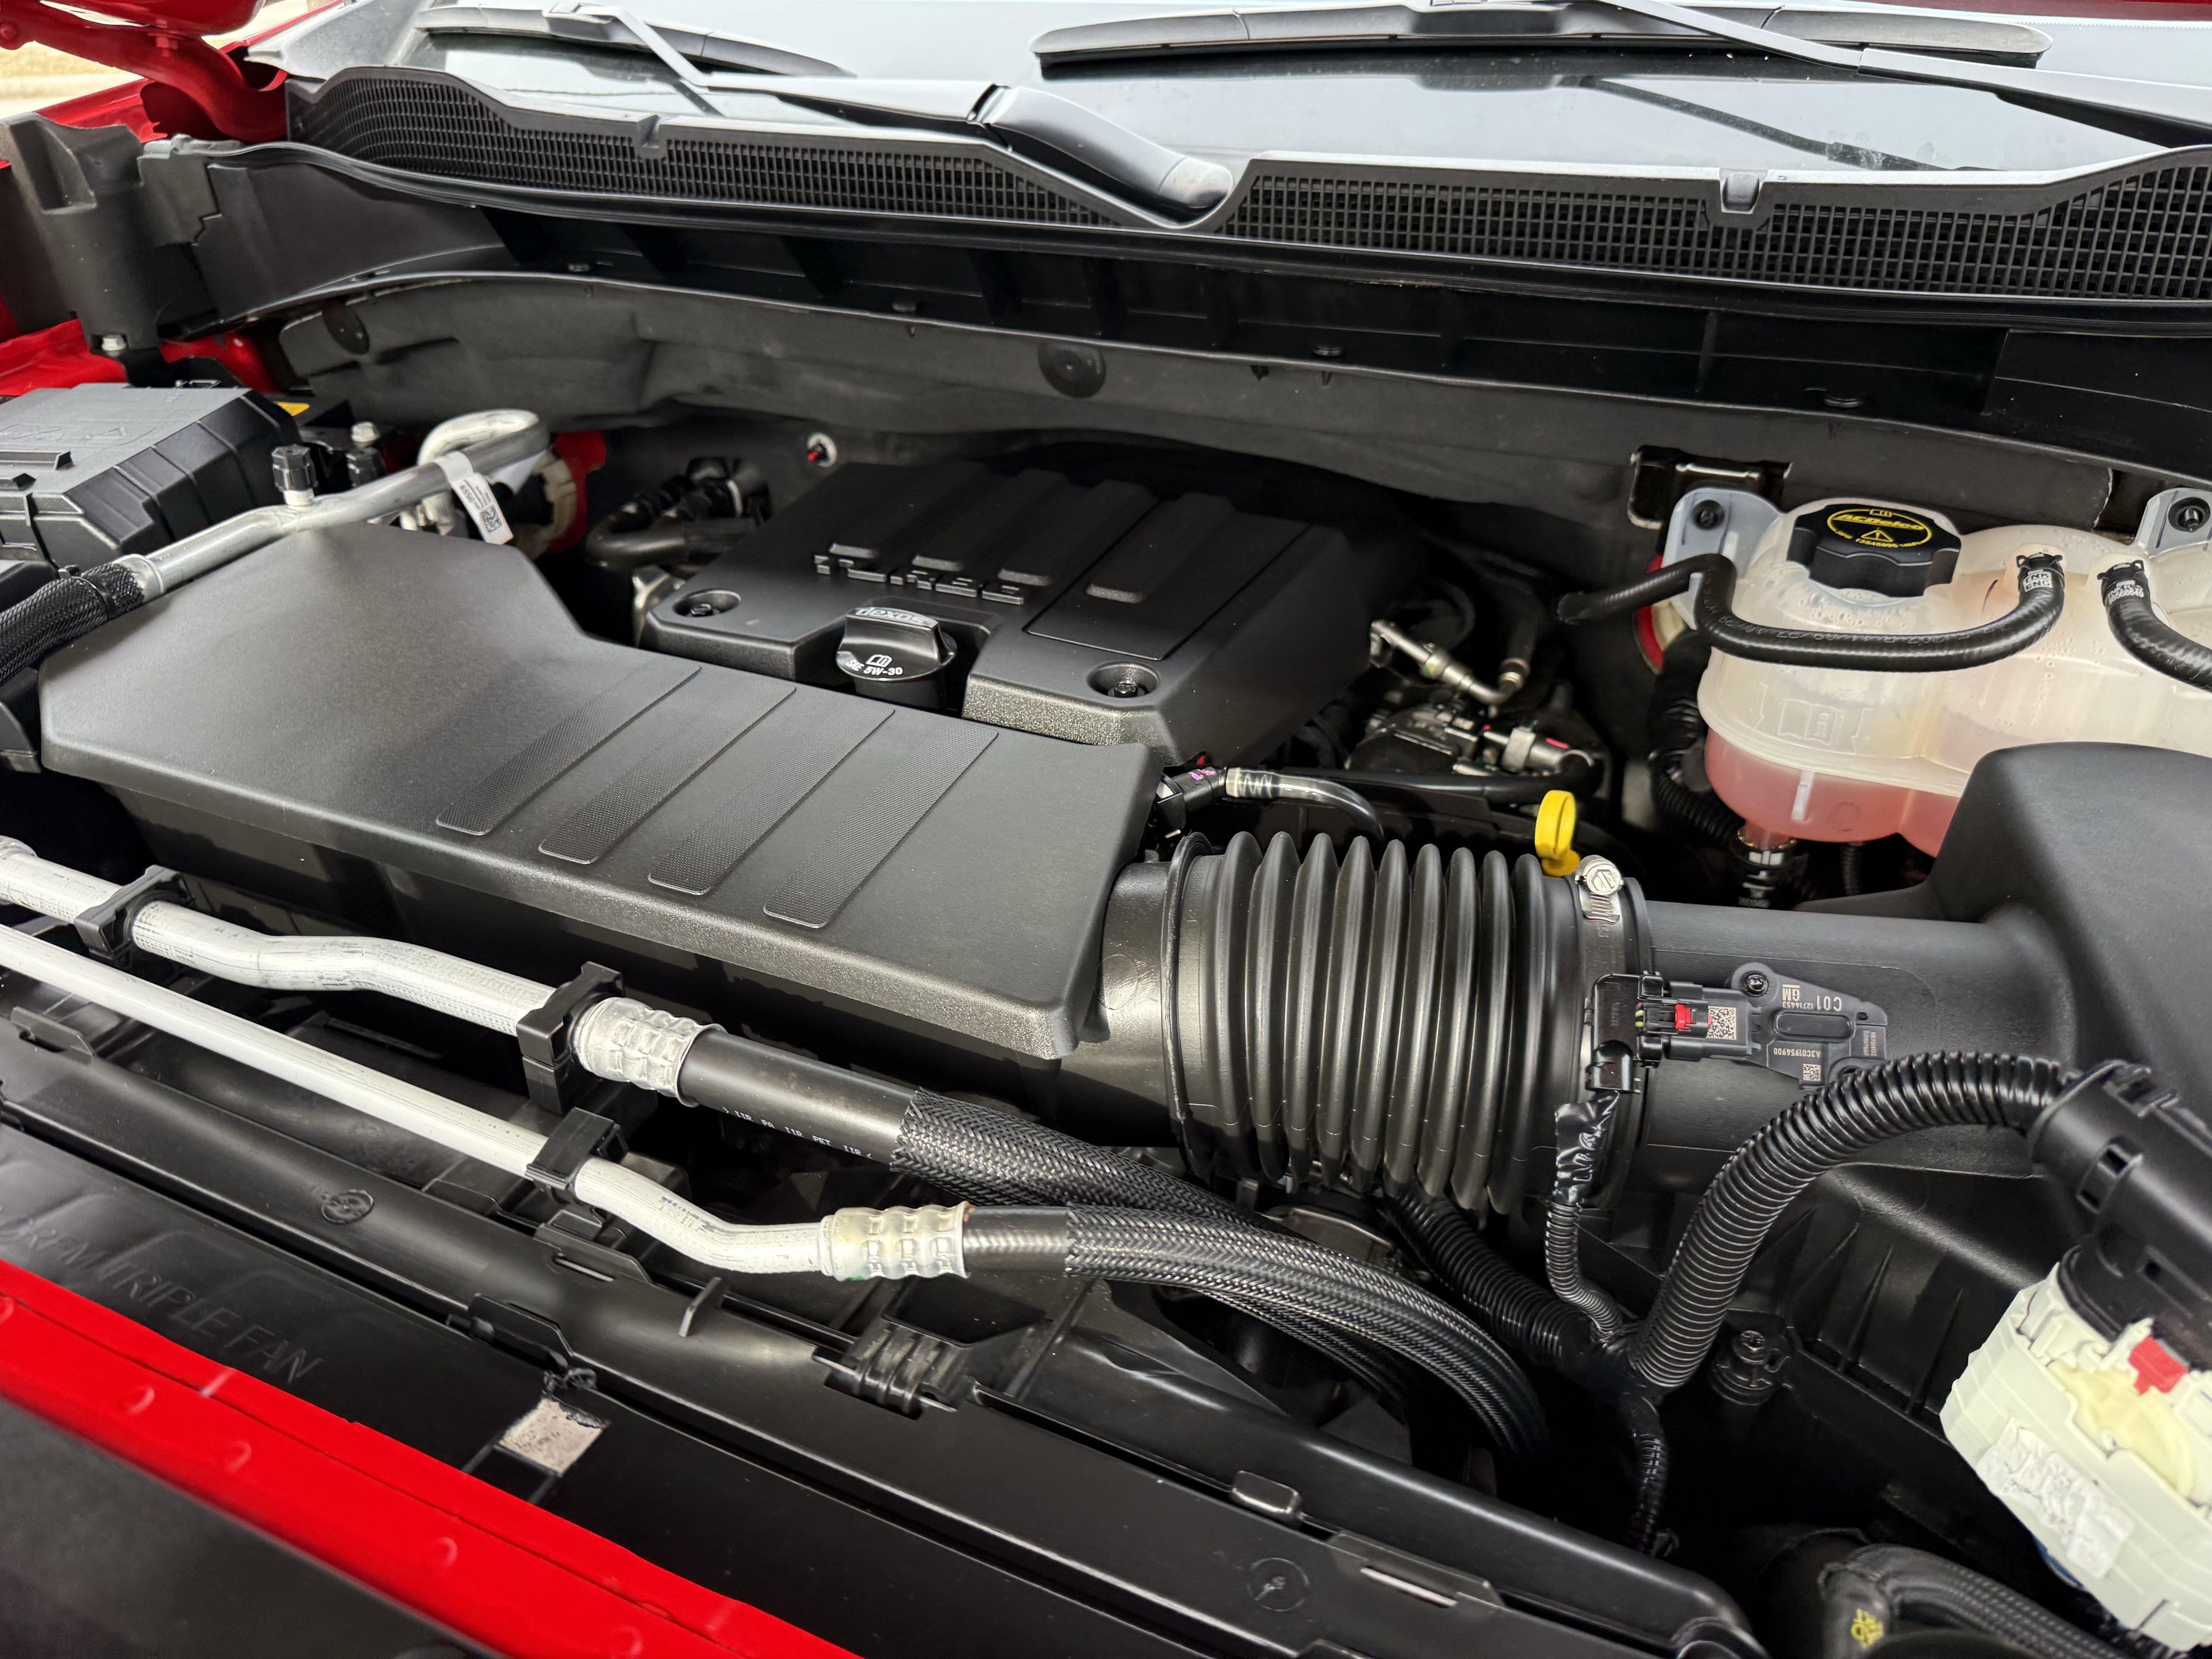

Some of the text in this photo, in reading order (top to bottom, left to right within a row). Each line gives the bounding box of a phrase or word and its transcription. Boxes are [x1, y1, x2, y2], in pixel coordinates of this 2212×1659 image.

[1834, 514, 1924, 531] ACDelco
[2025, 573, 2049, 584] TNK
[2025, 580, 2050, 590] ENG
[855, 607, 926, 624] dexos
[846, 659, 903, 676] SAE 5W-30
[1782, 988, 1800, 1001] GM
[1817, 995, 1842, 1012] C01
[812, 1135, 831, 1146] PET
[97, 1259, 245, 1338] TRIPLE
[226, 1324, 324, 1384] FAN
